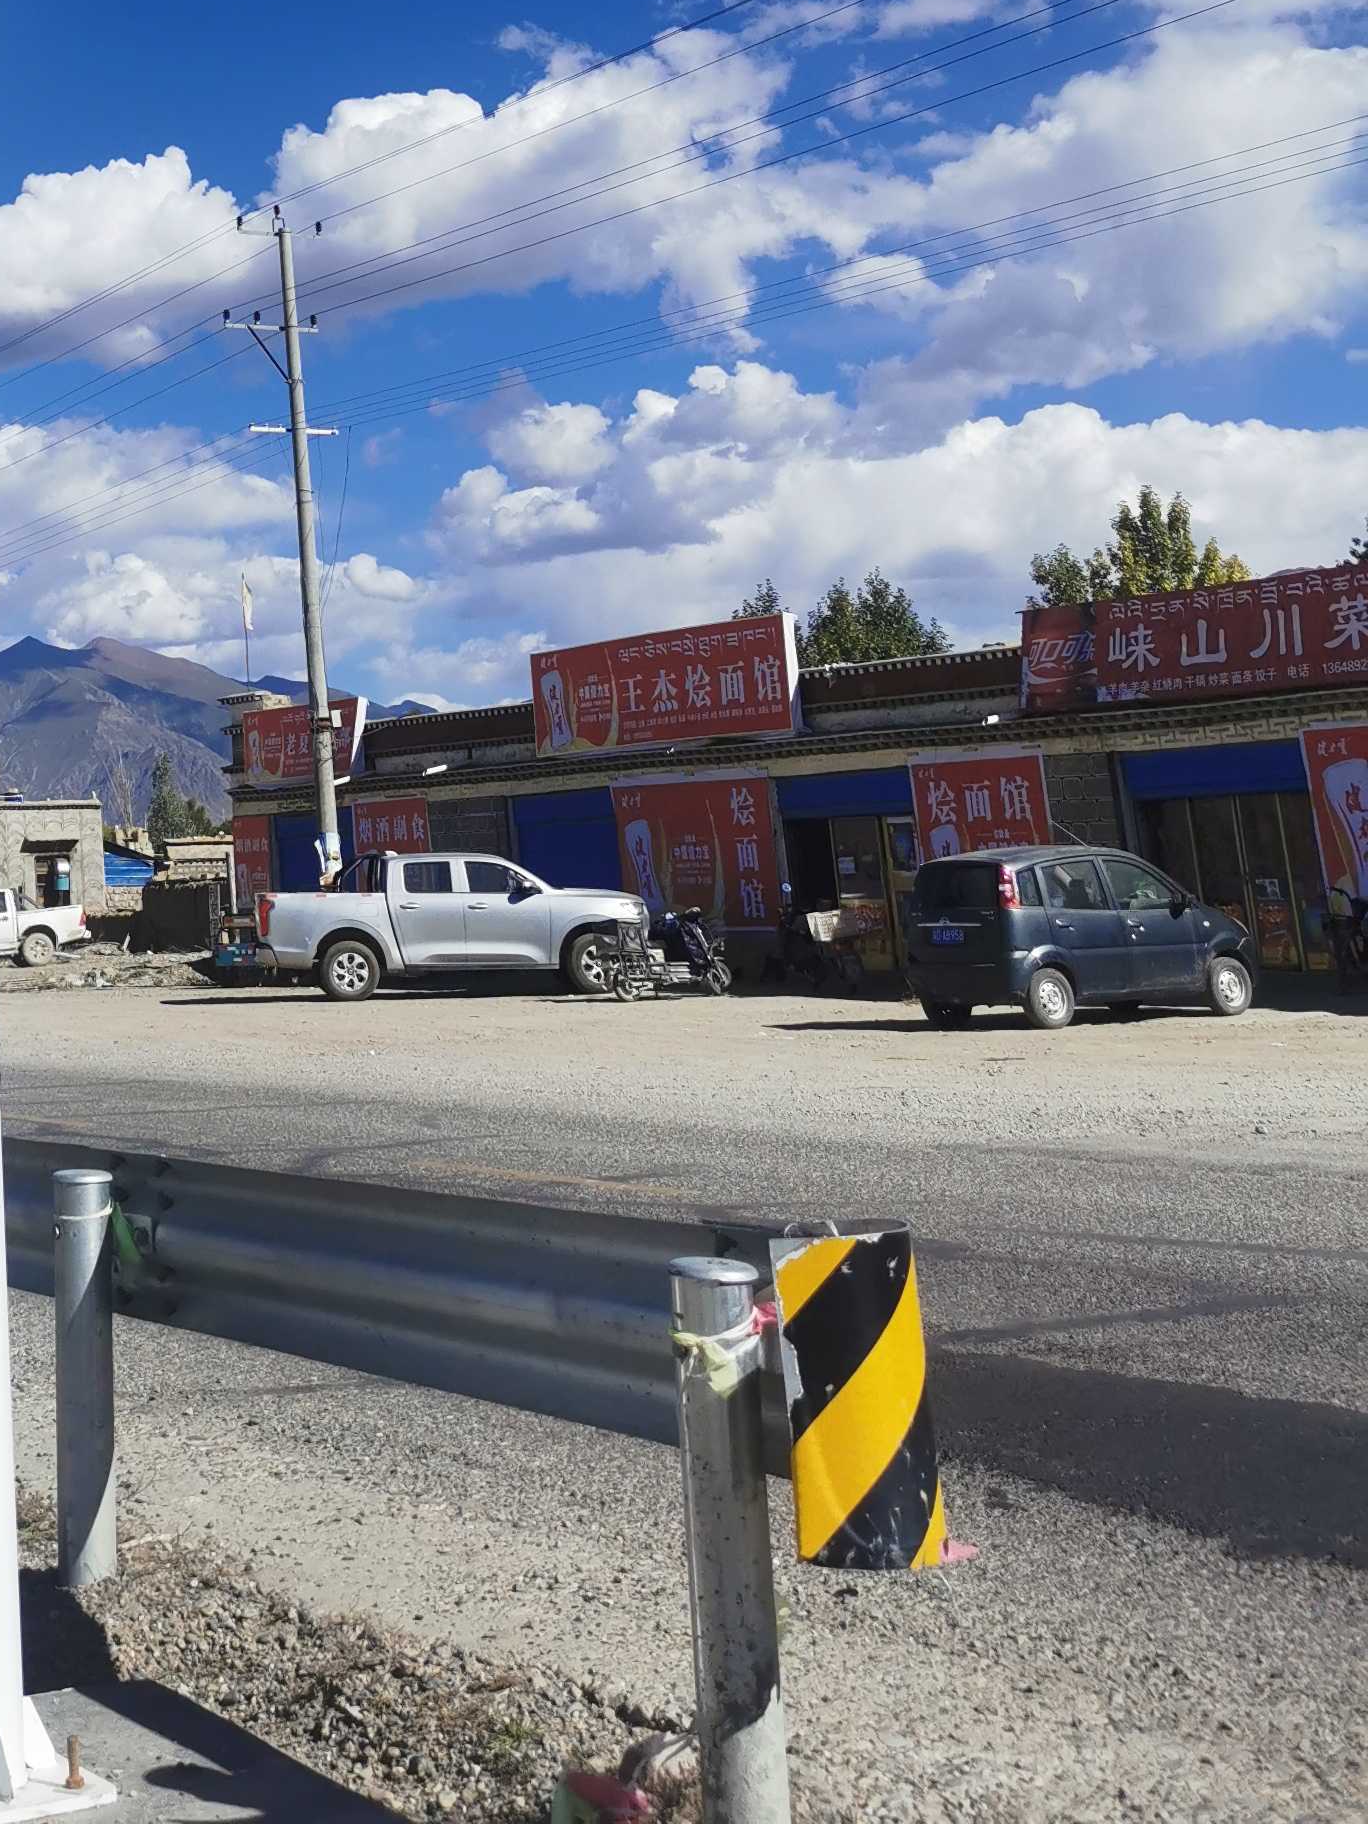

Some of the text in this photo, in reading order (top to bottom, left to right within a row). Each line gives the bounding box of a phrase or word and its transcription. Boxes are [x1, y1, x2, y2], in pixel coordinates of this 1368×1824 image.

[1107, 593, 1368, 672] 崃山川菜
[619, 654, 783, 714] 王杰烩面馆
[927, 775, 1032, 824] 烩面馆
[730, 786, 767, 920] 烩面馆
